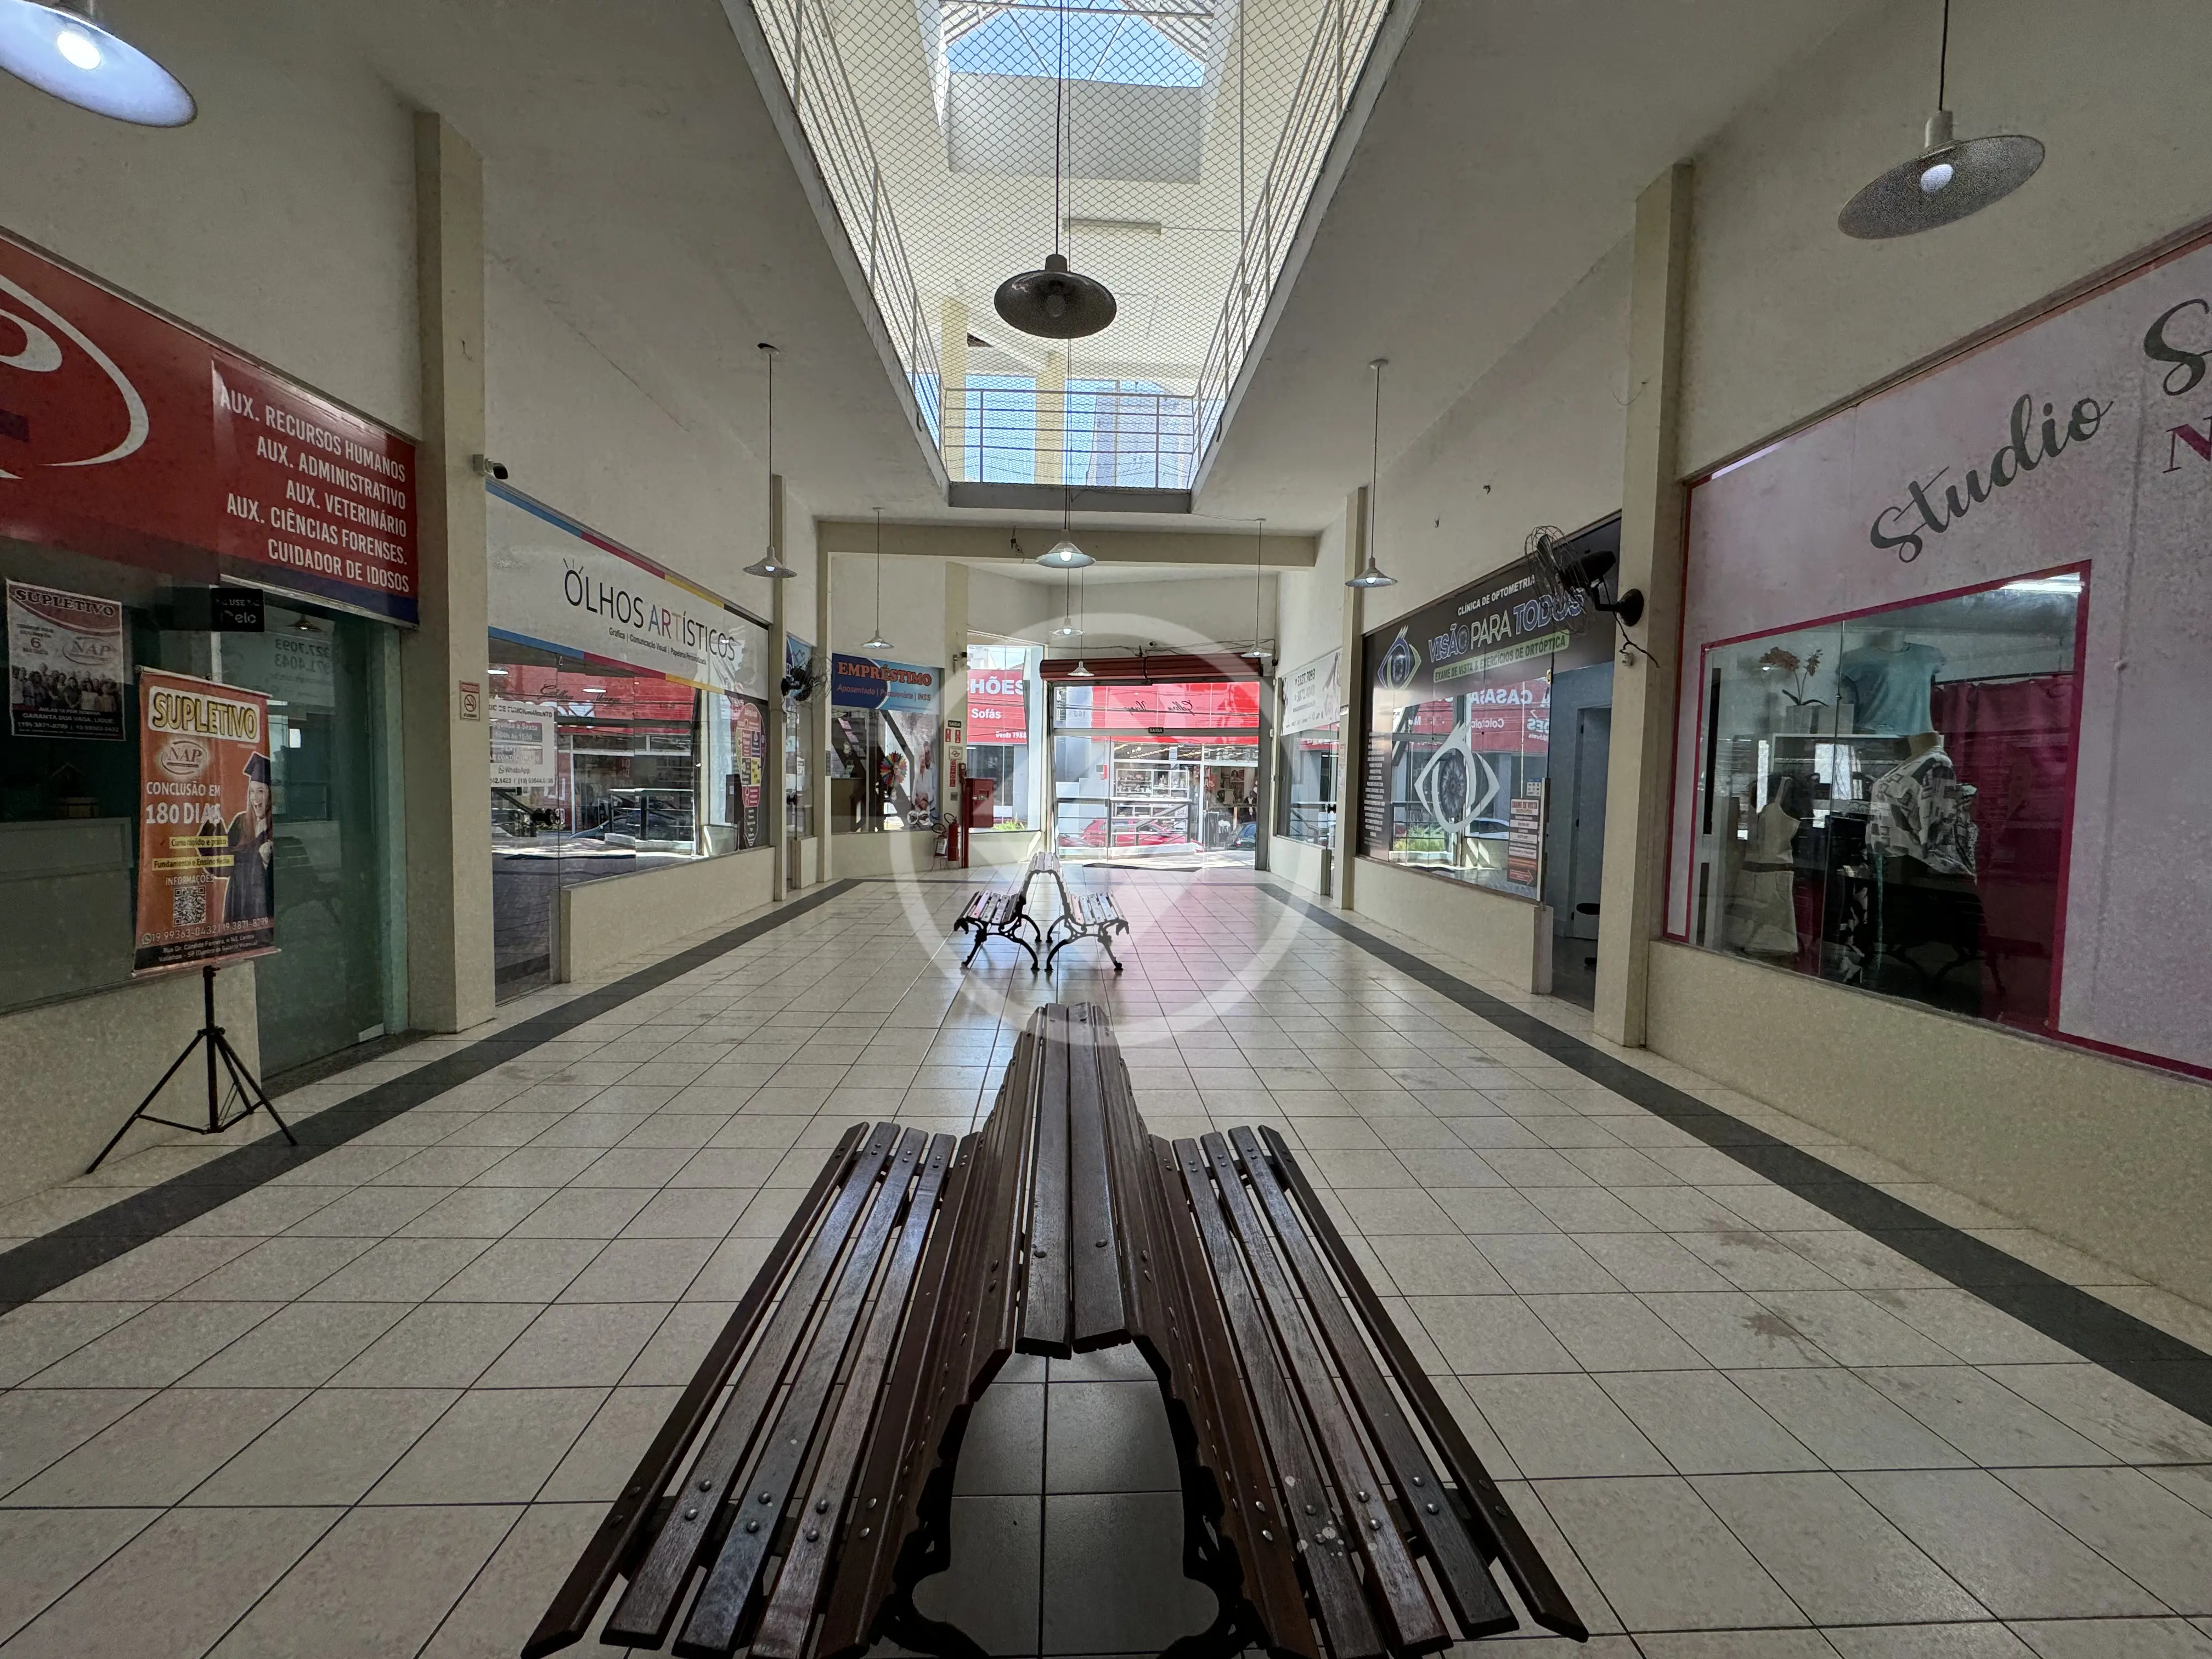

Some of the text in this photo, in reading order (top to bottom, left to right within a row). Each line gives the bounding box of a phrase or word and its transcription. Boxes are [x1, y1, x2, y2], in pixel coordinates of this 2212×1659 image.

[220, 386, 406, 483] AUX. RECURSOS HUMANOS
[256, 436, 406, 510] AUX. ADMINISTRATIVO
[1870, 394, 2114, 563] Studio
[227, 493, 408, 566] AUX. CIÊNCIAS FORENSES.
[285, 479, 407, 538] AUX. VETERINÁRIO
[268, 538, 410, 593] CUIDADOR DE IDOSOS
[15, 589, 115, 617] SUPLETIVO
[565, 569, 735, 661] OLHOS ARTÍSTICOS
[1457, 574, 1536, 617] CLÍNICA DE OPTOMETRIA
[1428, 623, 1470, 663] VISÃO
[1470, 610, 1512, 650] PARA
[1435, 668, 1451, 681] EXAME
[1451, 667, 1458, 678] DE
[1459, 663, 1474, 675] VISTA
[1480, 651, 1514, 670] EXERCÍCIOS
[1515, 648, 1523, 659] DE
[1525, 635, 1566, 657] ORTÓPTICA
[837, 684, 876, 696] Aposentado
[917, 692, 932, 702] INSS
[838, 661, 932, 686] EMPRÉSTIMO
[153, 692, 258, 740] SUPLETIVO
[971, 708, 1002, 720] Sofás
[167, 747, 203, 763] NAP
[146, 779, 206, 797] CONCLUSÃO
[145, 802, 221, 824] 180 DIAS
[166, 874, 215, 885] INFORMAÇÕES
[152, 933, 161, 943] 19
[164, 924, 217, 940] 99363-0432
